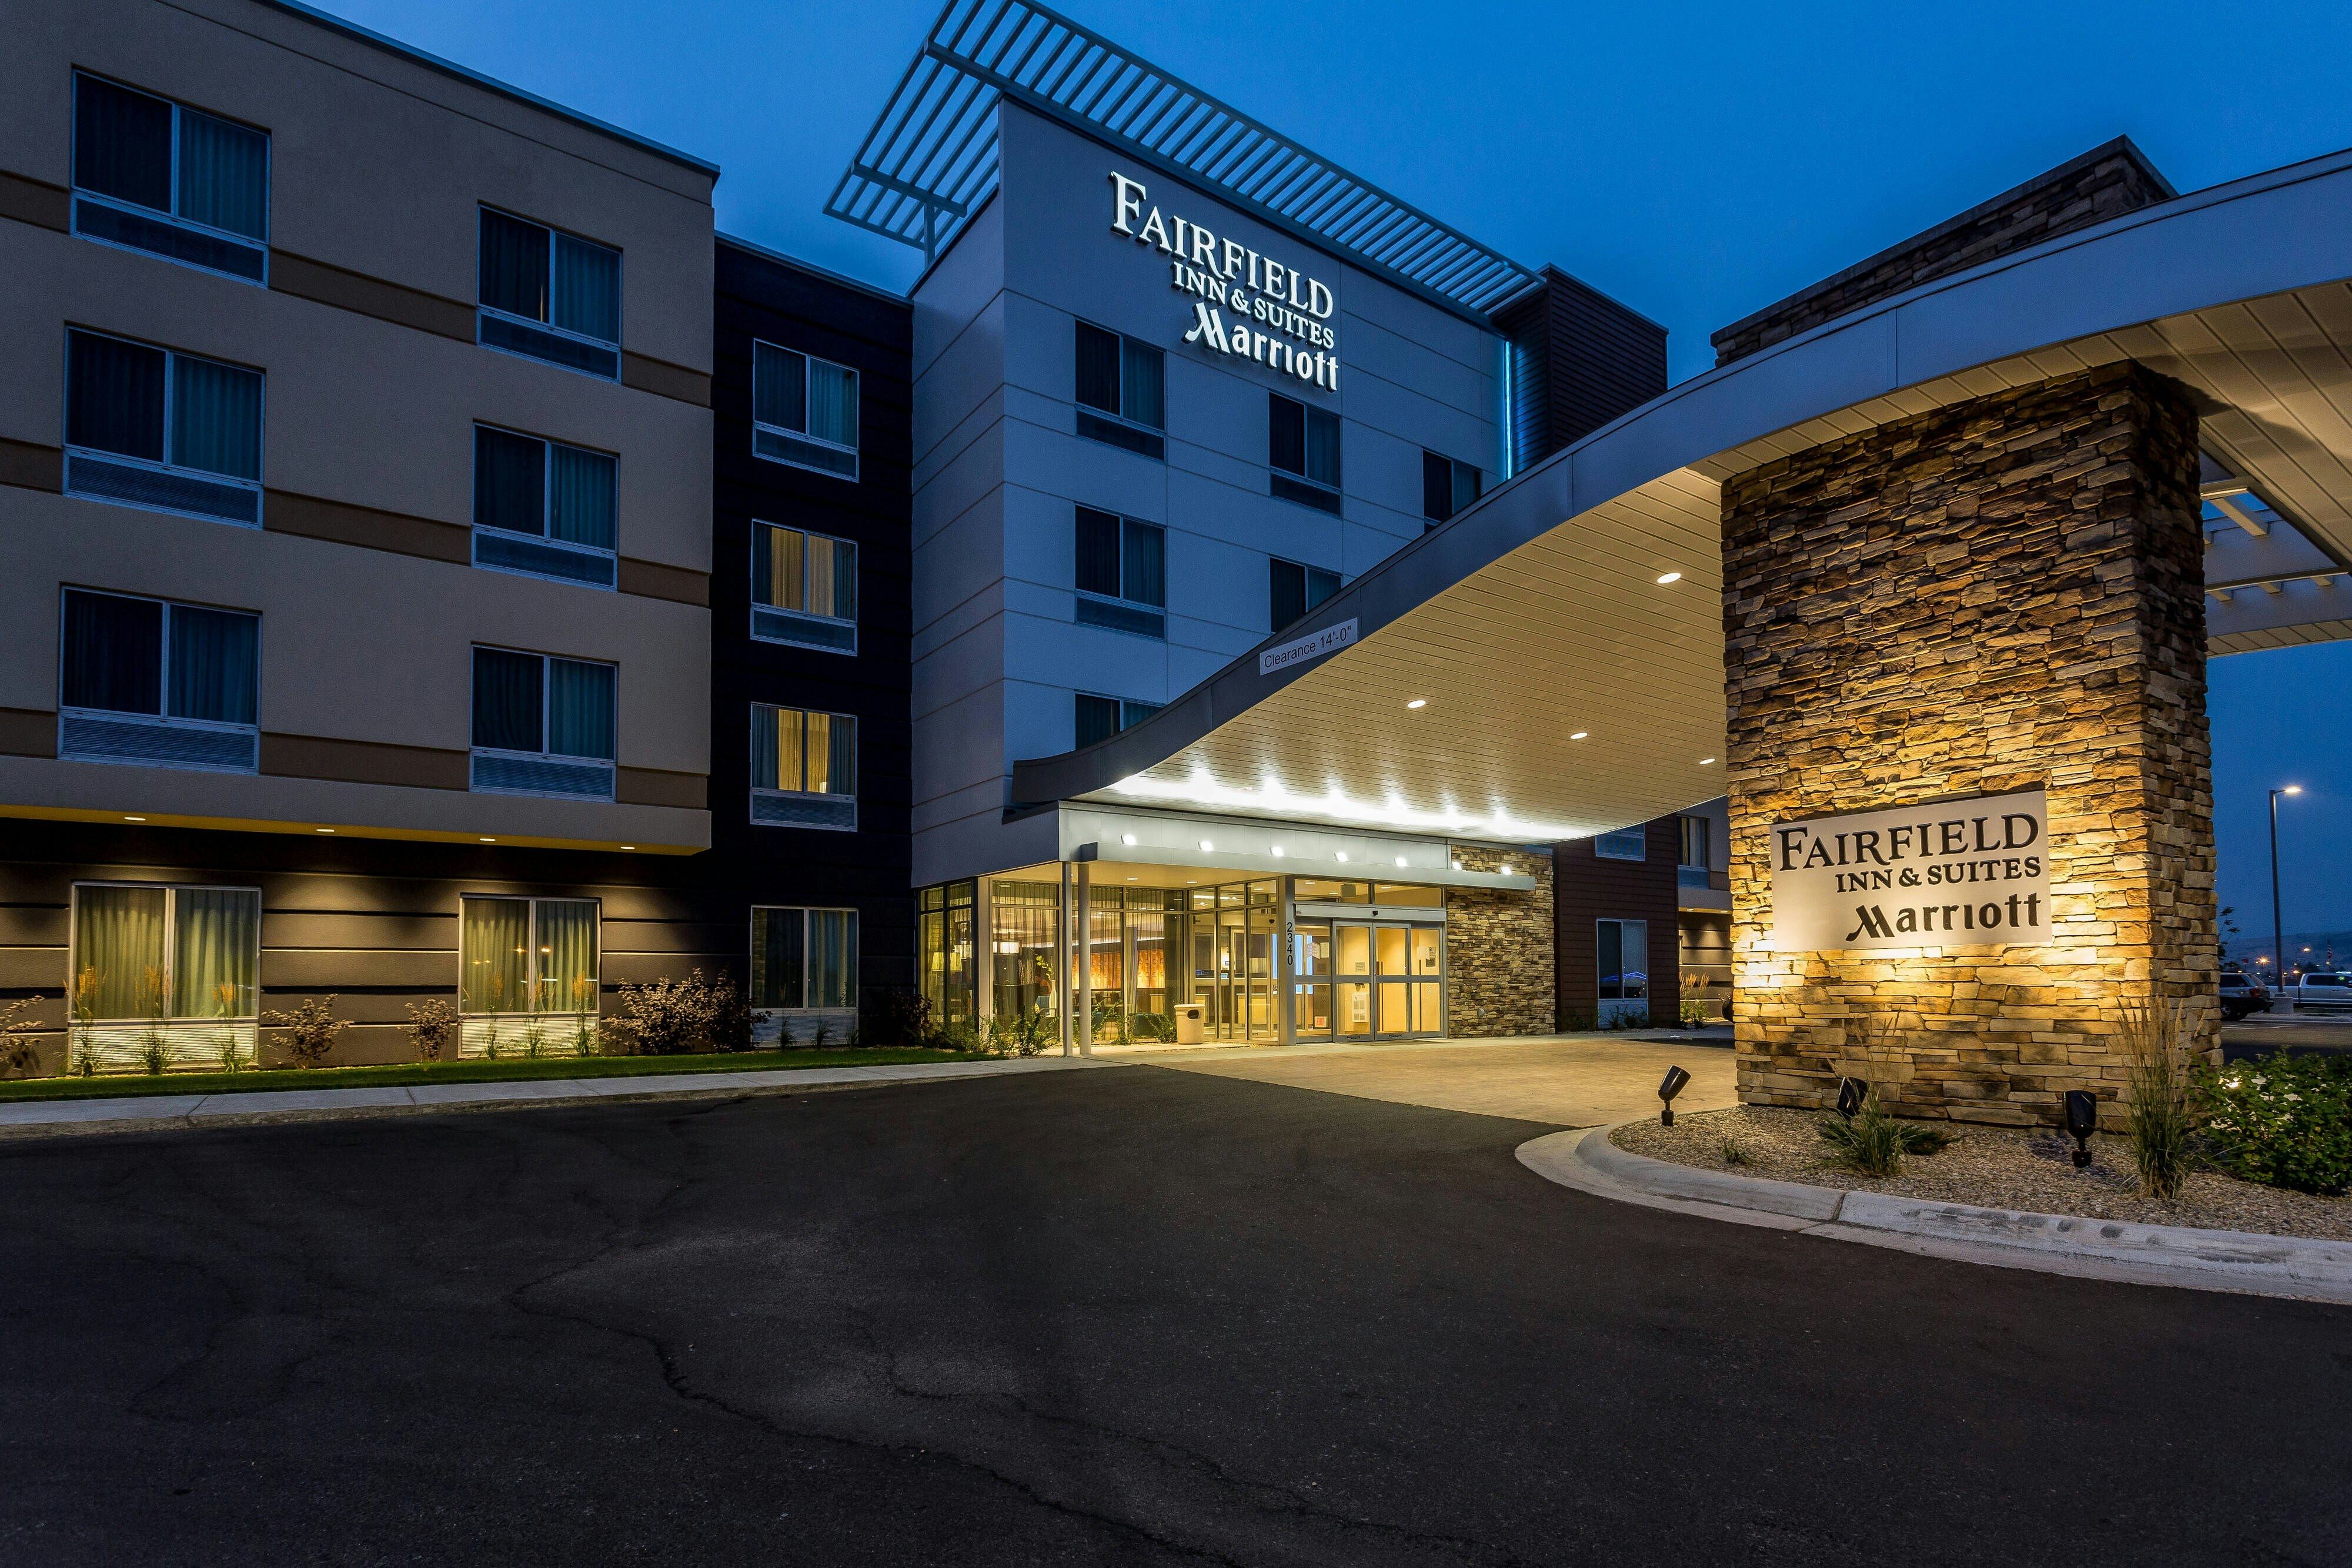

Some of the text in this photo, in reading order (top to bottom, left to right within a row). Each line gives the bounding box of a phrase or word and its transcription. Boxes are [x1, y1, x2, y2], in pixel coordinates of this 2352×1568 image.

[1109, 170, 1333, 318] FAIRFIELD
[1171, 261, 1334, 349] INN & SUITES
[1182, 302, 1338, 392] Marriott
[1265, 625, 1351, 668] Clearance 14'-0"
[1776, 813, 2039, 871] FAIRFIELD
[1835, 856, 2042, 893] INN & SUITES
[1845, 892, 2041, 942] Marriott
